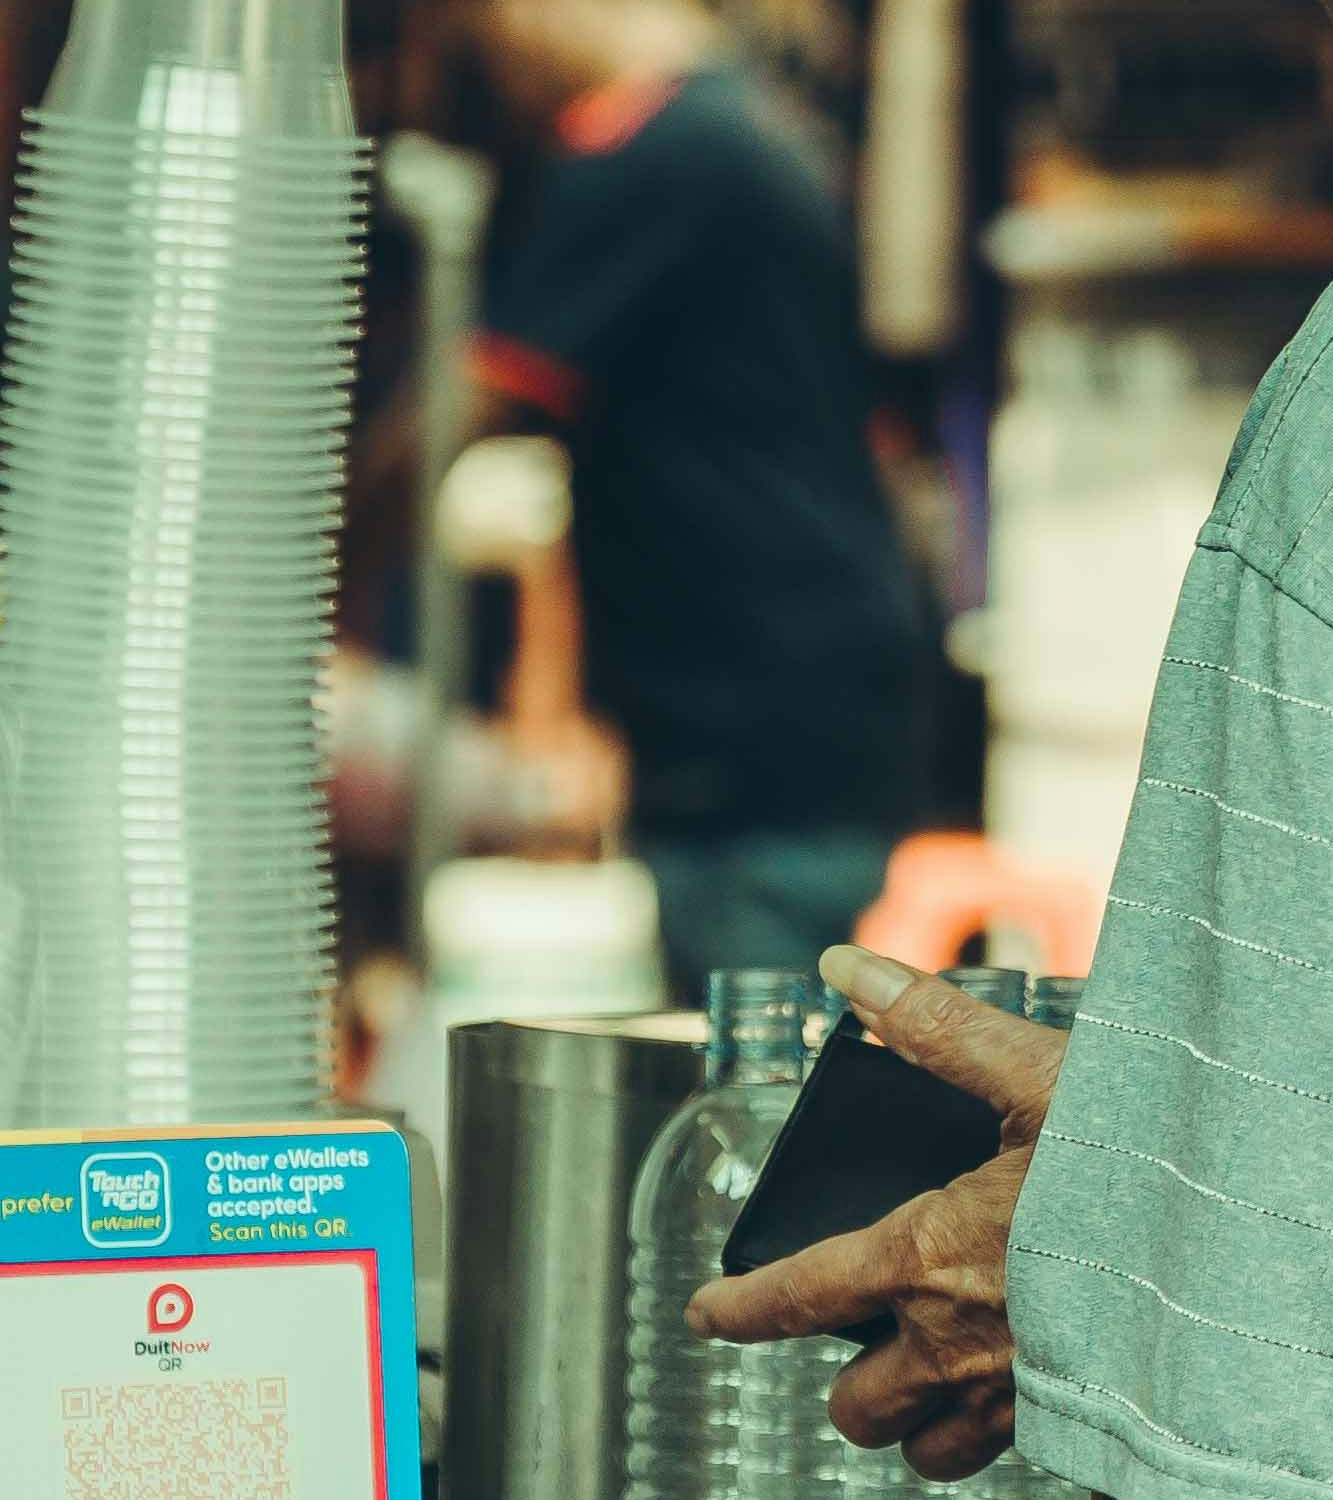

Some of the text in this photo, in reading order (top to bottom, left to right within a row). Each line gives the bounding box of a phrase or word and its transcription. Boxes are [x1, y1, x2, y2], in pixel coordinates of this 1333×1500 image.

[205, 1146, 369, 1172] Other eWallets
[88, 1169, 161, 1192] Touch
[206, 1172, 345, 1199] & bank apps
[1, 1192, 75, 1220] prefer
[207, 1196, 318, 1220] accepted.
[91, 1215, 162, 1232] eWallet
[209, 1222, 263, 1242] Scan
[269, 1220, 308, 1240] this
[134, 1340, 210, 1356] DuitNow
[158, 1357, 182, 1372] QR
